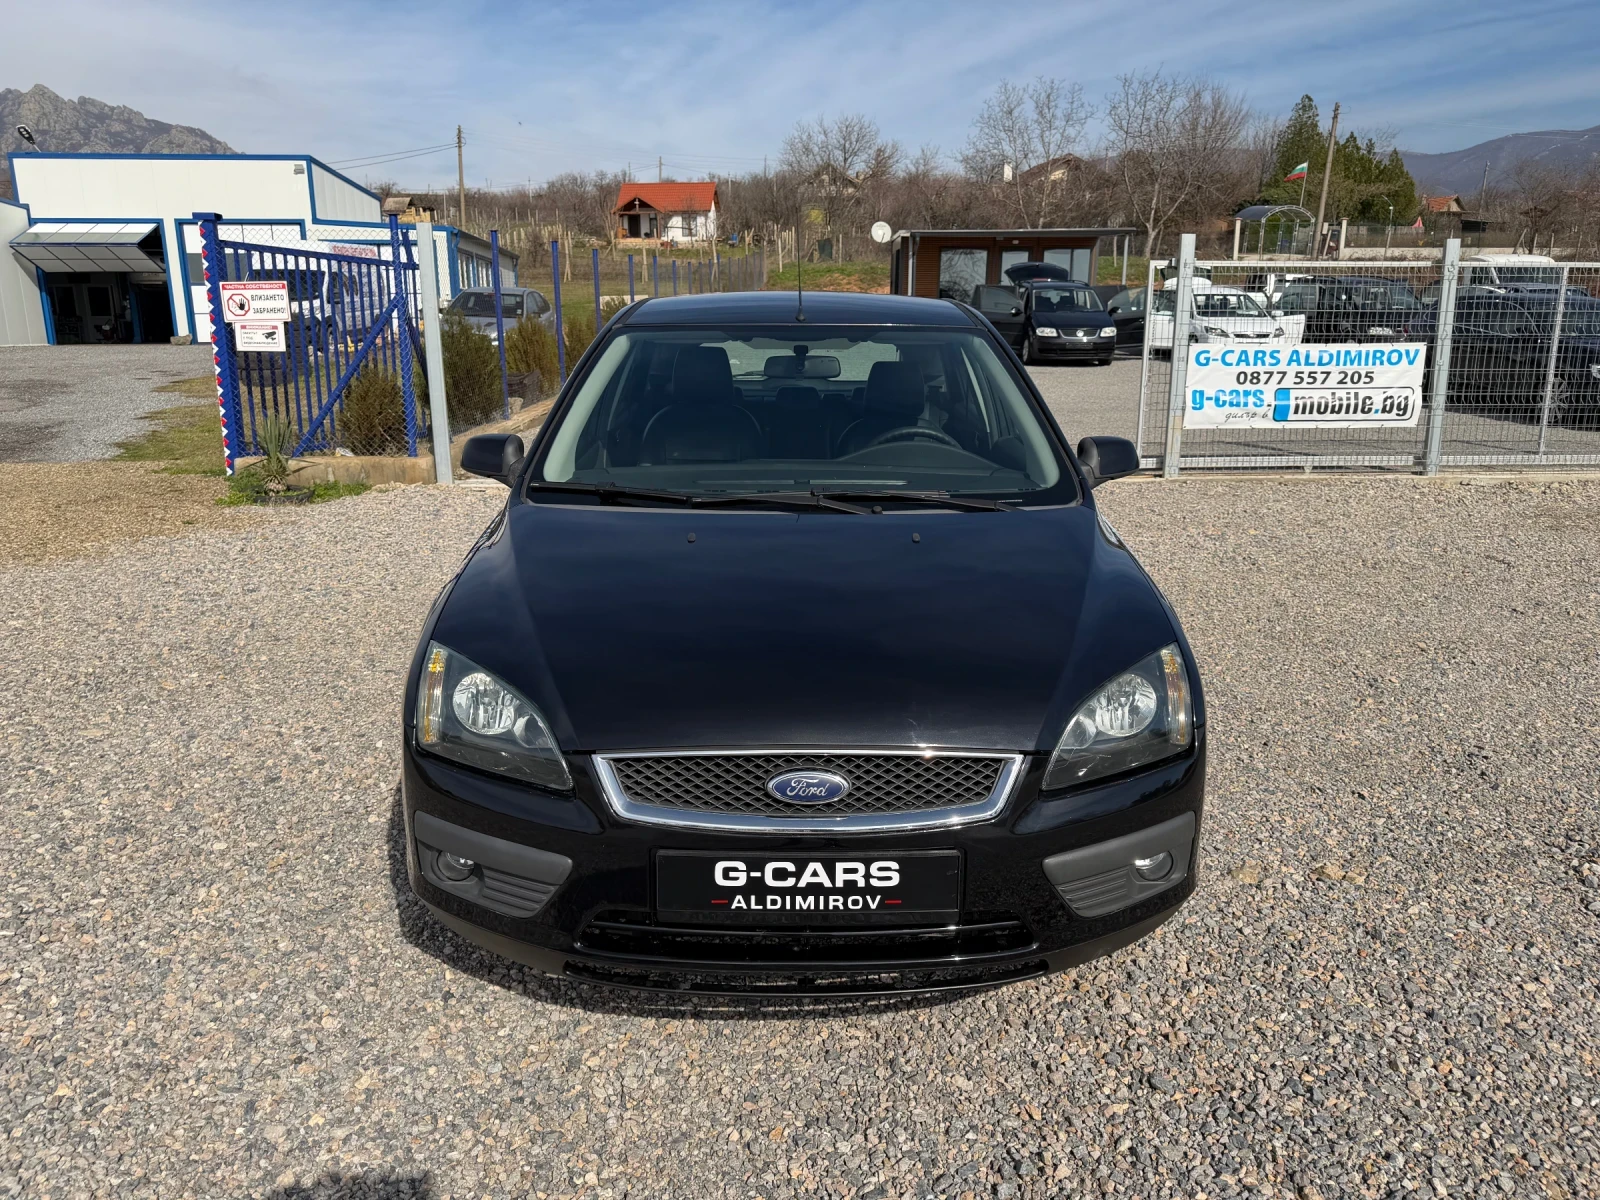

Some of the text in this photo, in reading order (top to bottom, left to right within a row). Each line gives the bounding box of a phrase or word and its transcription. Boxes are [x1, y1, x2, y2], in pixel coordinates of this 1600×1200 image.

[1194, 348, 1421, 367] G-CARS ALDIMIROV
[1236, 370, 1375, 385] 0877 557 205
[1293, 390, 1410, 417] mobile.bg
[786, 777, 830, 797] Ford
[714, 860, 900, 888] G-CARS
[730, 895, 882, 910] ALDIMIROV
